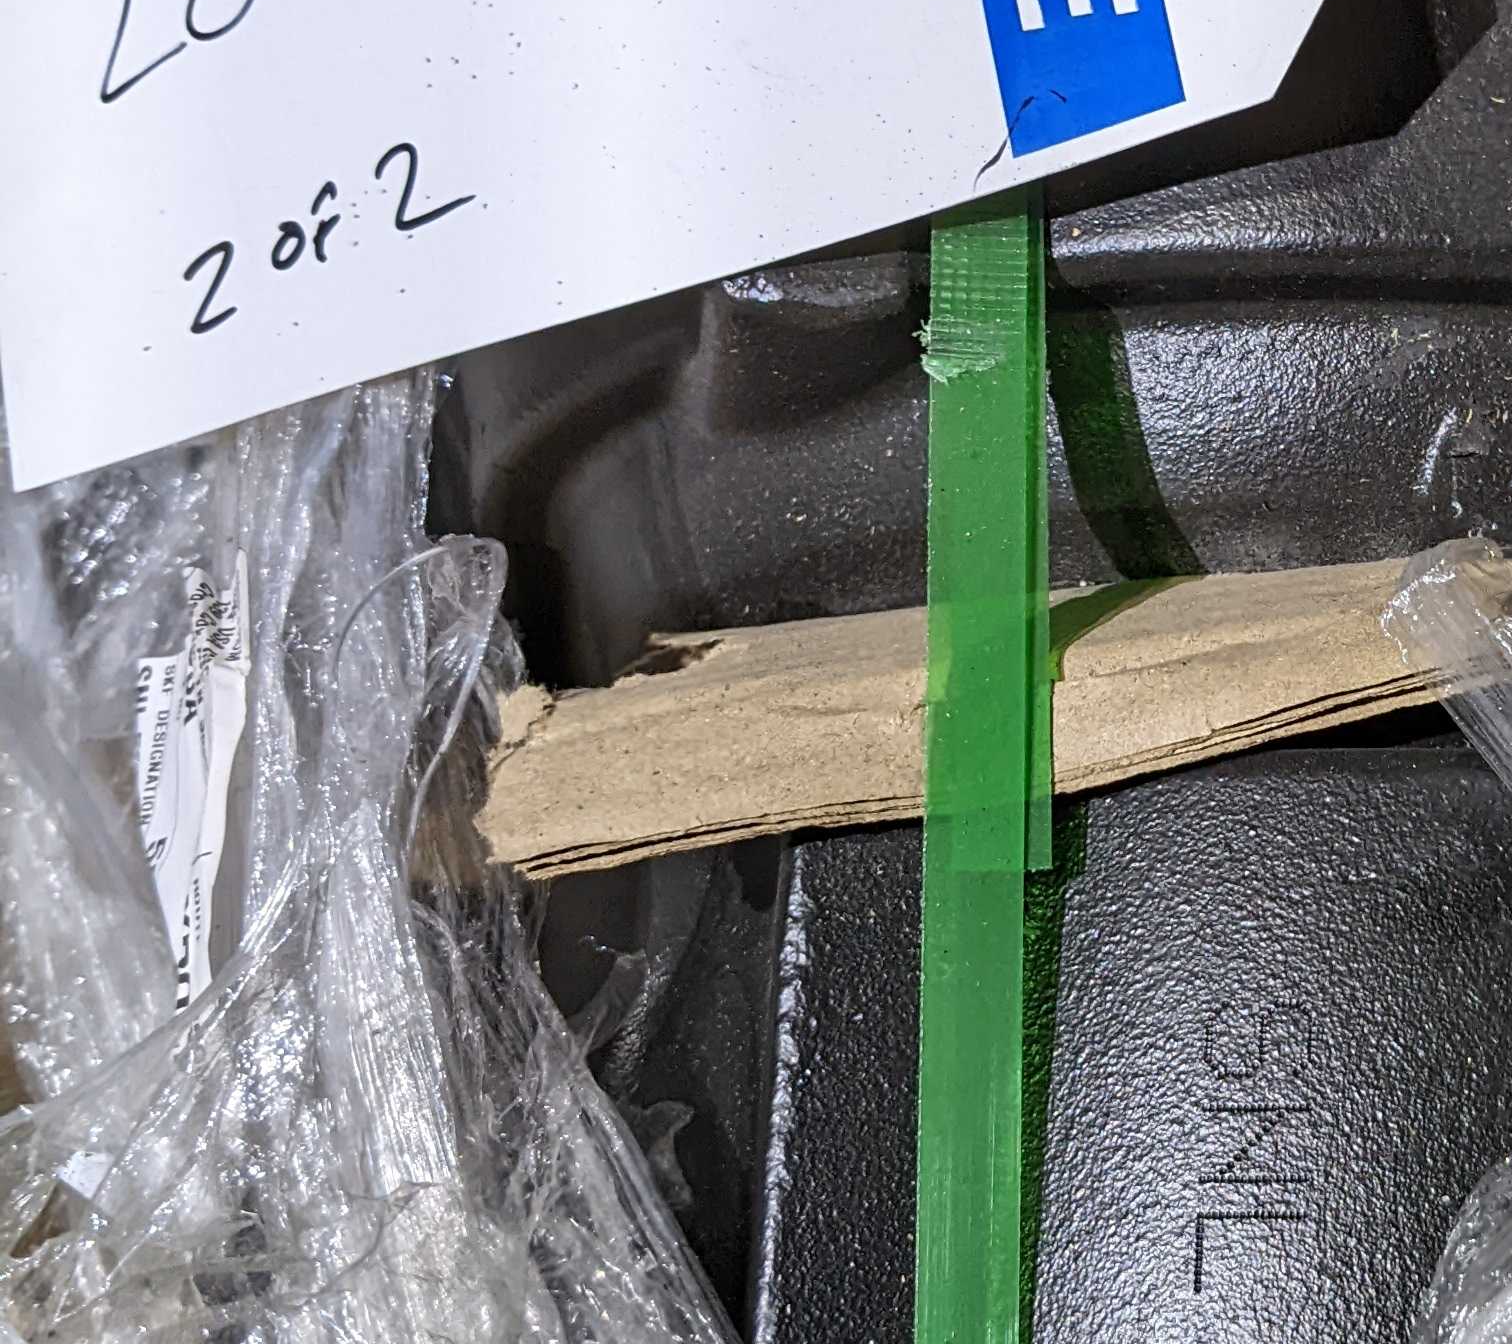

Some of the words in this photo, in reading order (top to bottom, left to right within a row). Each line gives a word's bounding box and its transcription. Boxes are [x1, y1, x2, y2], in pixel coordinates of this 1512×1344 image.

[183, 239, 238, 335] 2
[374, 141, 477, 231] 2
[140, 708, 171, 828] DESIGNATION
[1194, 999, 1316, 1296] SNL
